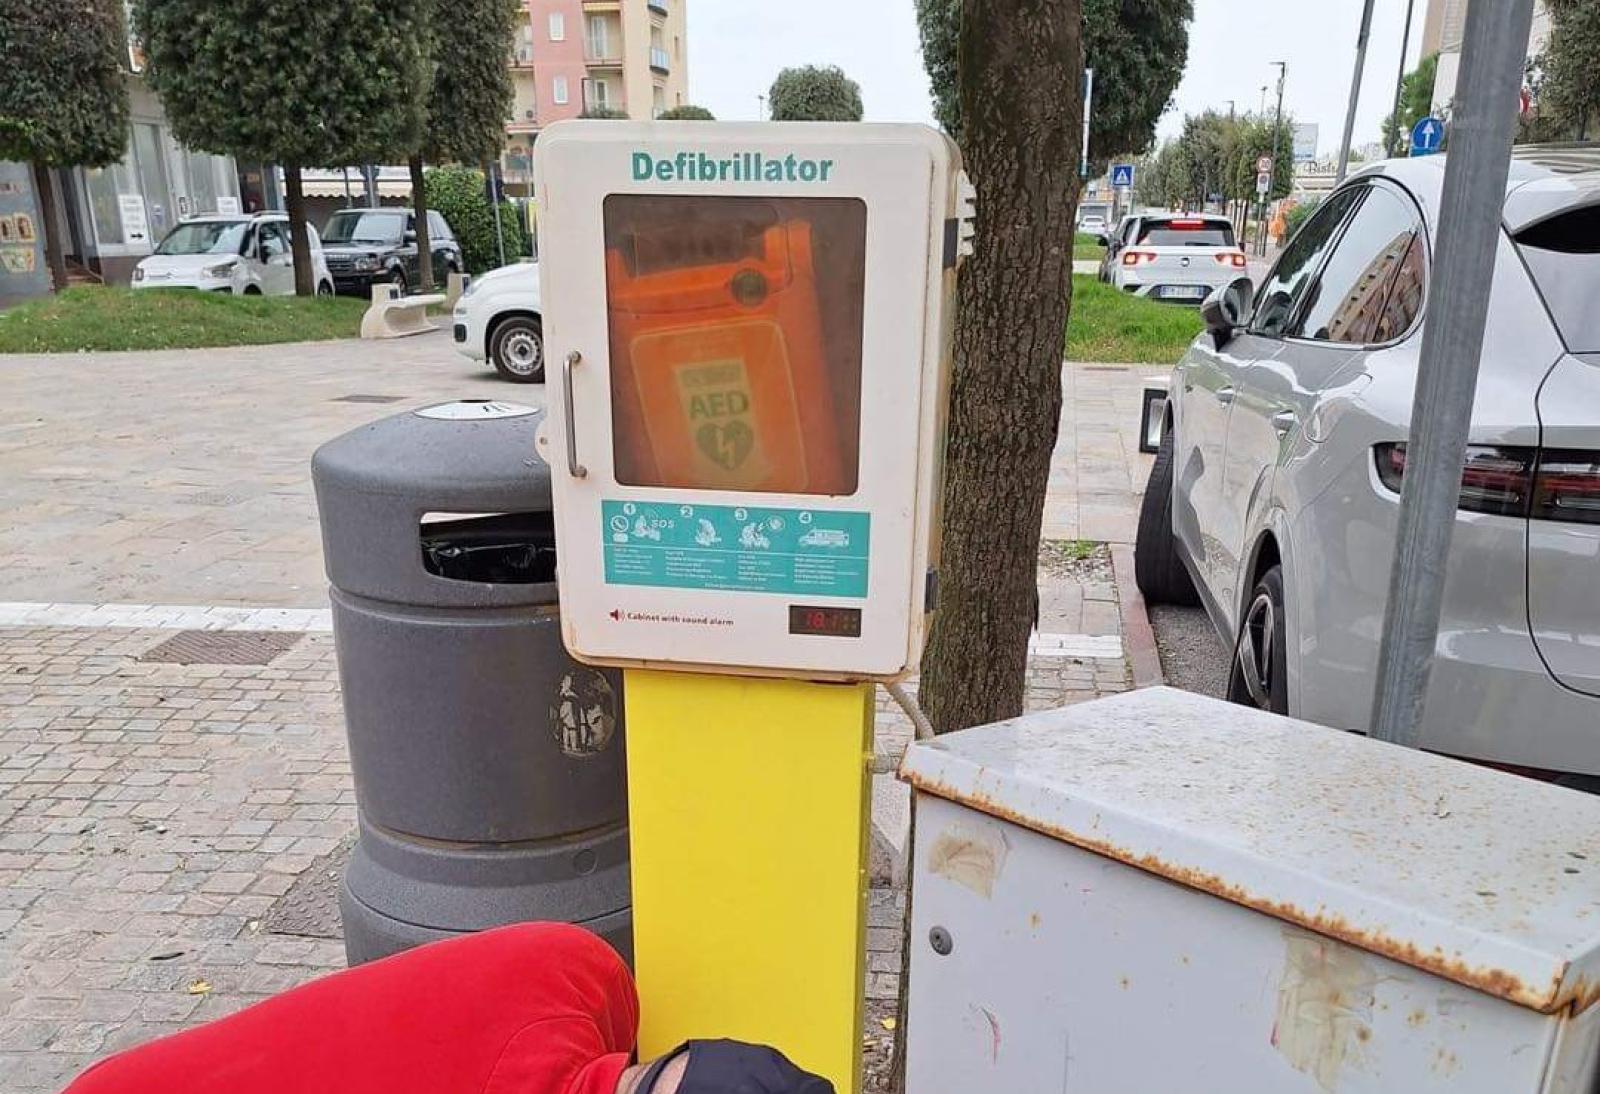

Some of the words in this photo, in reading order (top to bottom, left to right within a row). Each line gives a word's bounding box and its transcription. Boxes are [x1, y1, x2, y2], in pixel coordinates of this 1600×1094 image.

[631, 152, 834, 182] Defibrillator
[689, 390, 749, 420] AED
[651, 519, 675, 529] SOS
[627, 612, 660, 623] Cabinet
[661, 614, 679, 623] with
[682, 616, 708, 625] sound
[709, 617, 734, 626] alarm
